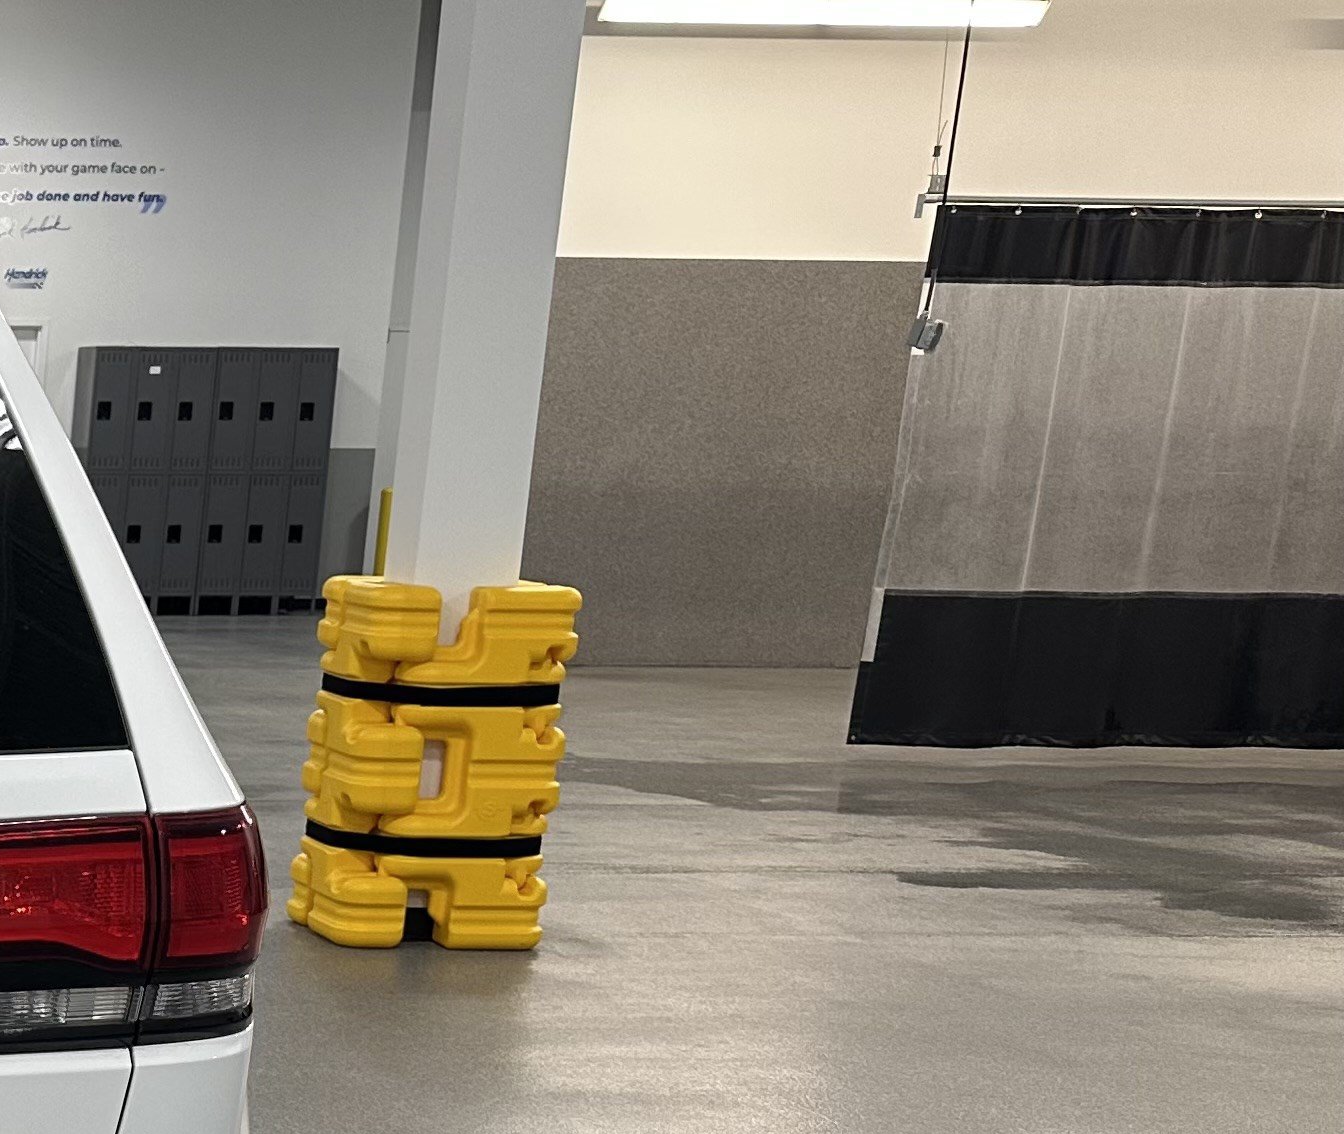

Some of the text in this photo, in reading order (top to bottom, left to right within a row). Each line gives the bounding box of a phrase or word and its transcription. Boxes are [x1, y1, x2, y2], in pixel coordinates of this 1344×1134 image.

[12, 135, 49, 147] Show
[51, 137, 68, 149] up
[70, 138, 87, 147] on
[9, 161, 37, 173] with
[39, 163, 69, 175] your
[71, 164, 108, 176] game
[110, 162, 137, 174] face
[140, 164, 157, 174] on
[11, 190, 33, 203] job
[36, 190, 70, 202] done
[73, 190, 100, 202] and
[102, 191, 135, 202] have
